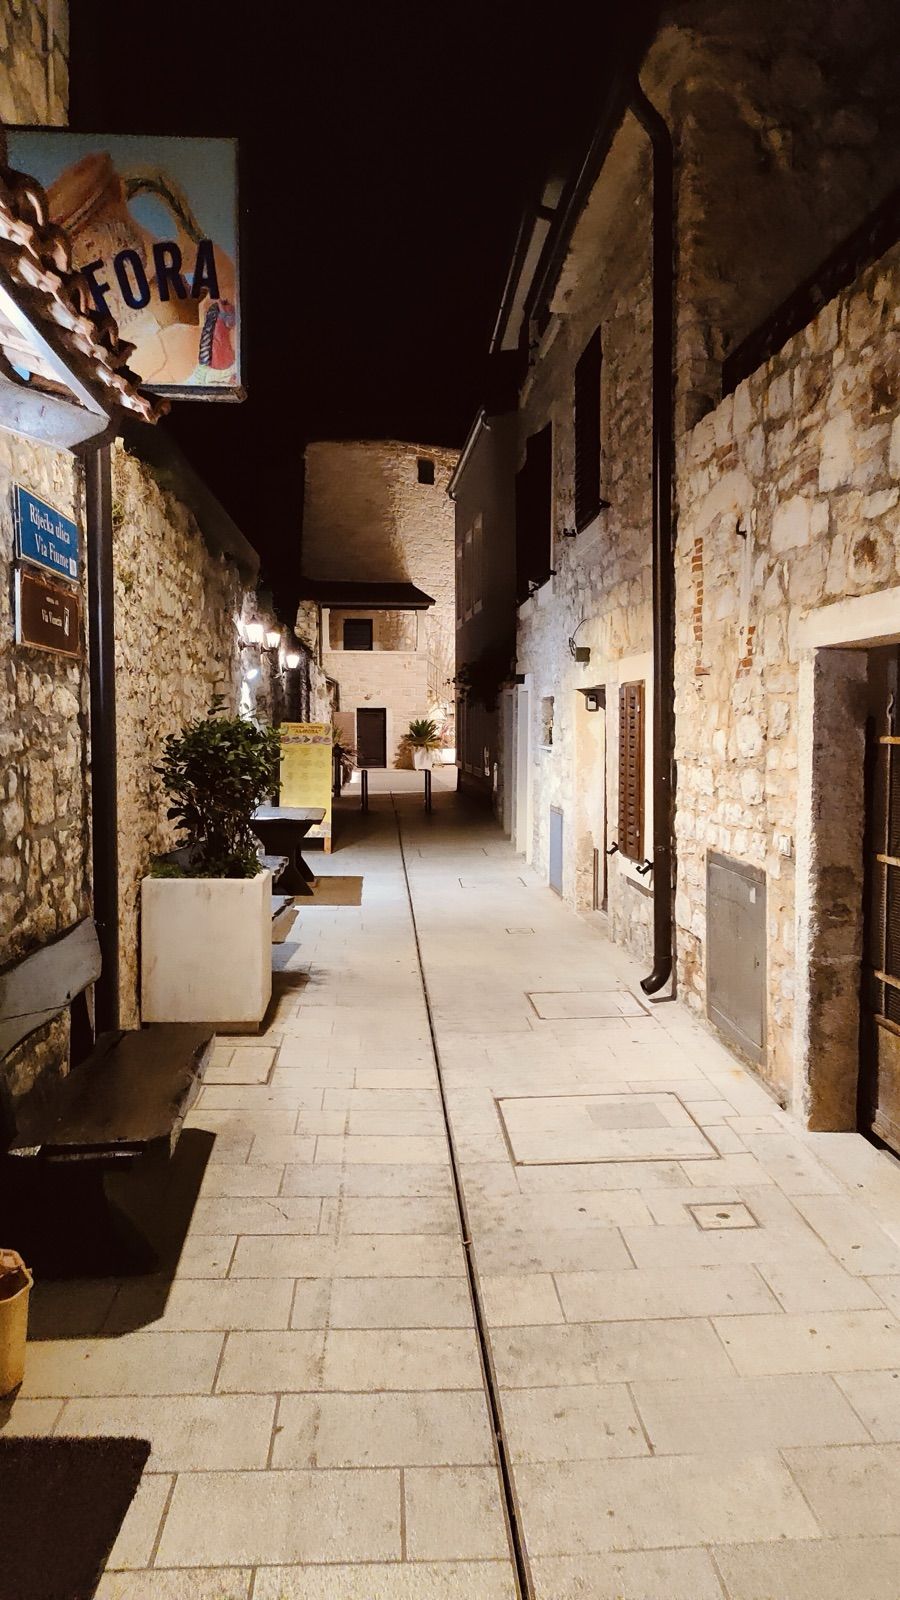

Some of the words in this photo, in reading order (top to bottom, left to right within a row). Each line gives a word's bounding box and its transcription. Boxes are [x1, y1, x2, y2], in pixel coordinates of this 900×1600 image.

[55, 521, 70, 545] ulica
[34, 533, 48, 557] Via
[48, 541, 69, 569] Fiume
